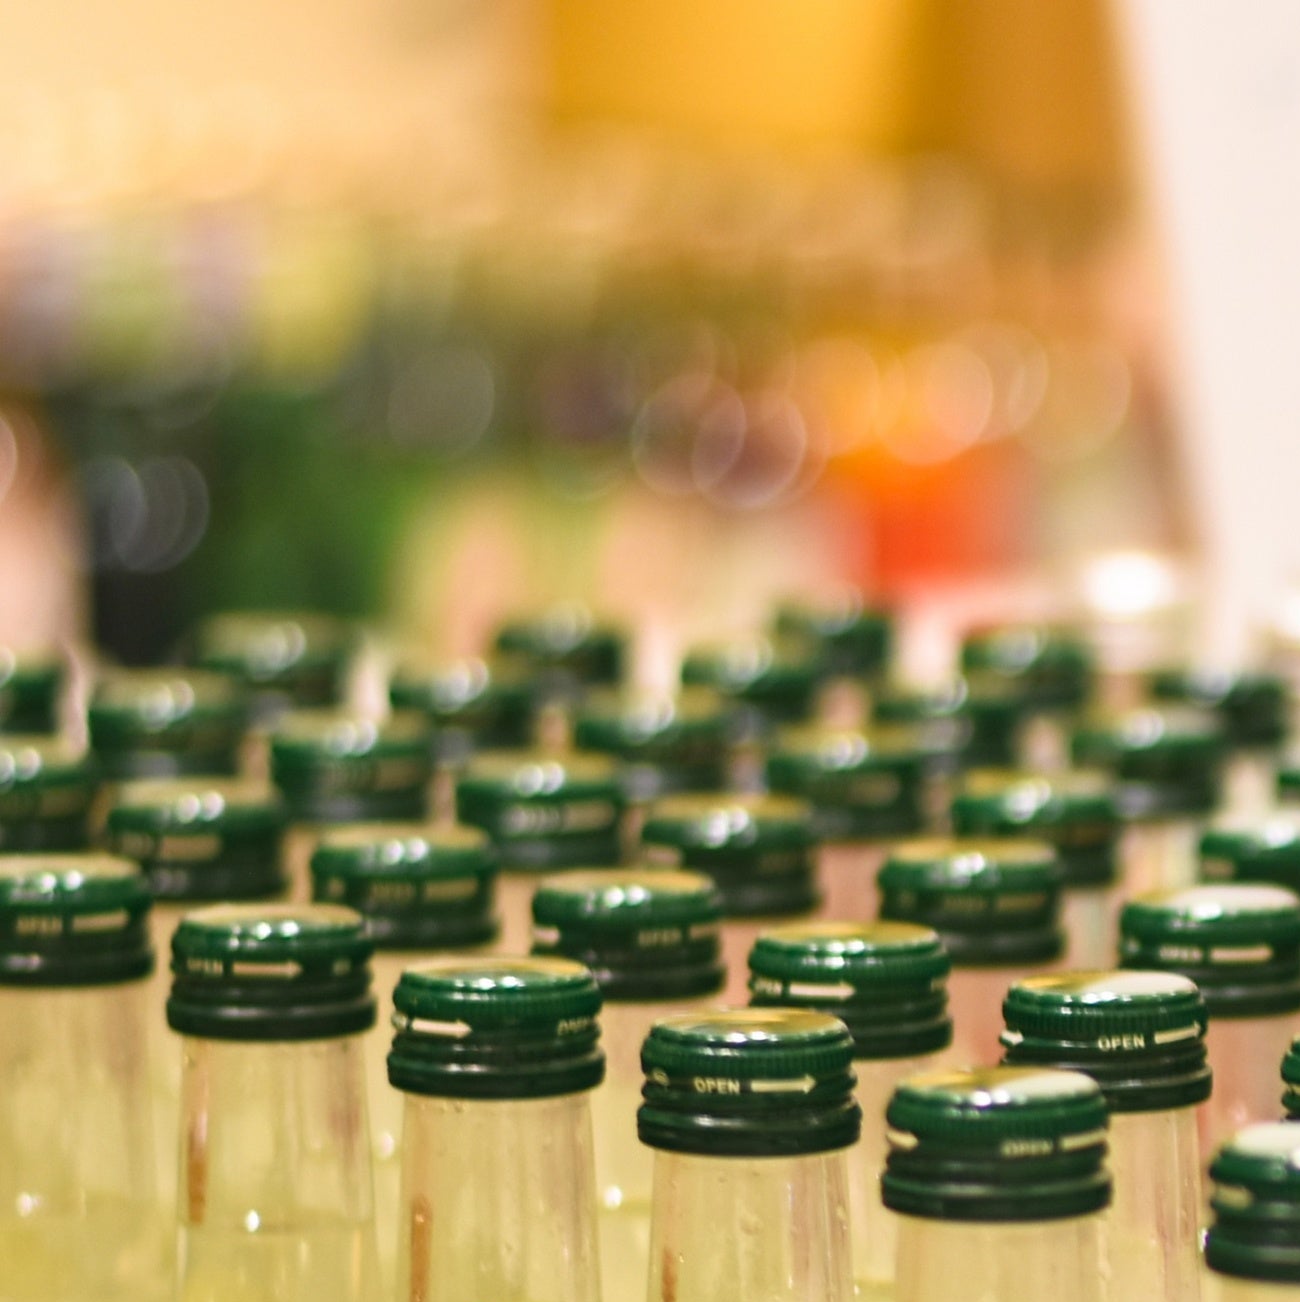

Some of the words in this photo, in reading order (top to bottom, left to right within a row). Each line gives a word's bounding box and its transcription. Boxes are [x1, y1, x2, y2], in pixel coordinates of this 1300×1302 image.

[1097, 1033, 1146, 1053] OPEN
[693, 1076, 741, 1095] OPEN
[1001, 1137, 1055, 1158] OPEN
